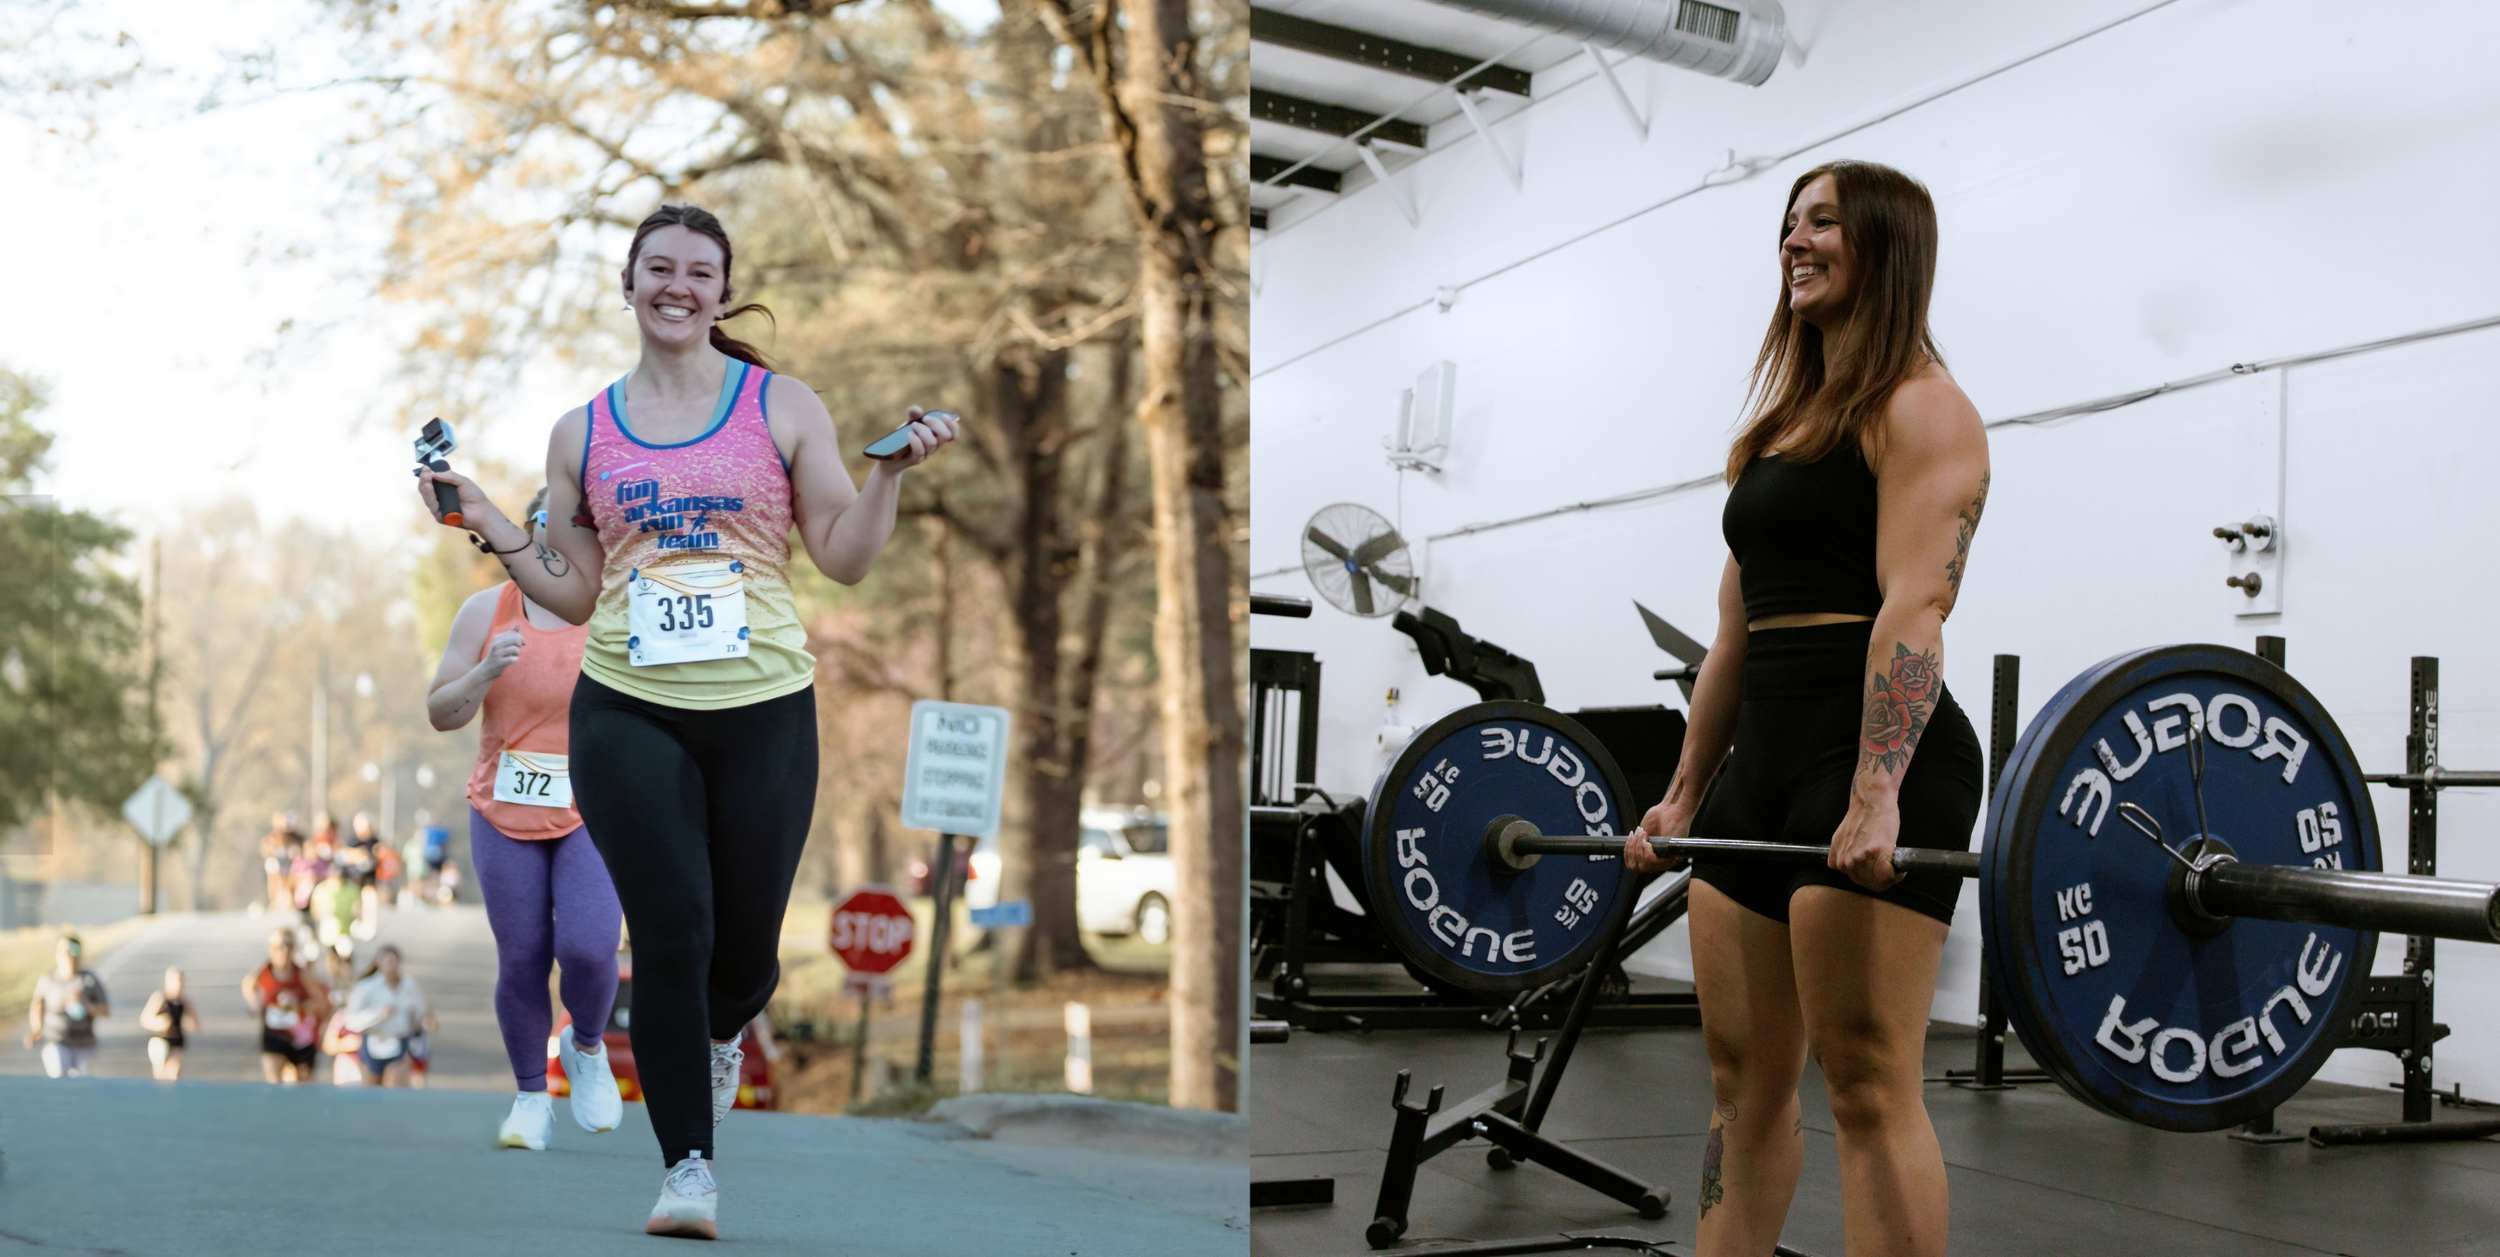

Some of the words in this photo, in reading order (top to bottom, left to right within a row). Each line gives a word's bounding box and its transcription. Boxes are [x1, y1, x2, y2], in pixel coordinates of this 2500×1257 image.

[657, 532, 719, 550] team
[657, 593, 714, 632] 335
[513, 771, 552, 796] 372
[832, 910, 914, 956] STOP
